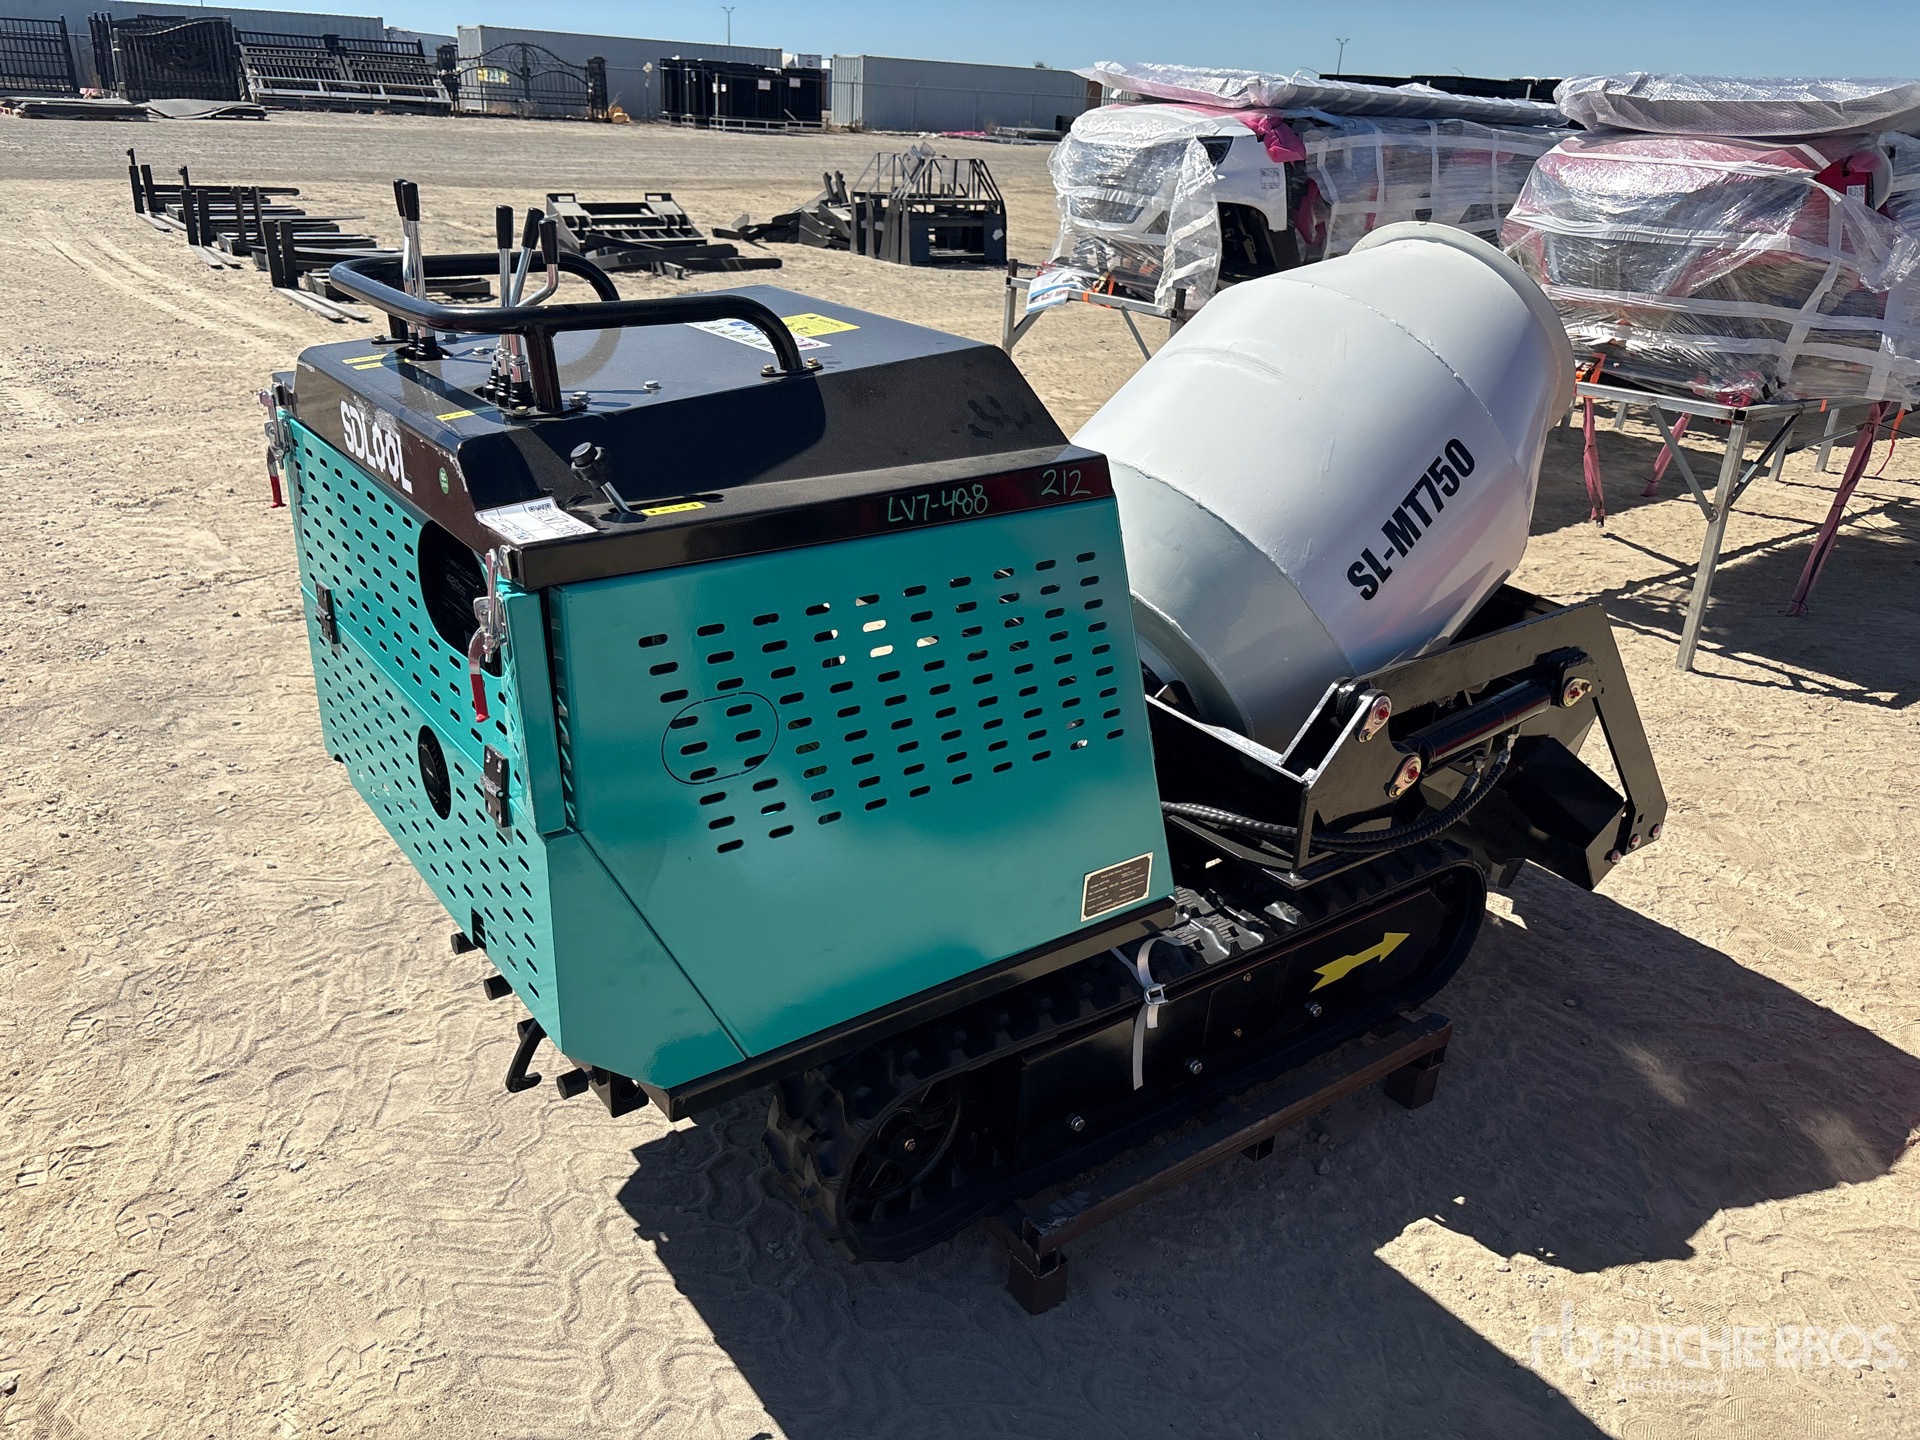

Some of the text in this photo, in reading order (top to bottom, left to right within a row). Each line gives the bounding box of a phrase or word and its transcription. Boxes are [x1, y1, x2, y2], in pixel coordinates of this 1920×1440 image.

[887, 483, 989, 523] LV7-488
[1041, 469, 1092, 497] 212
[1347, 438, 1475, 601] SL-MT750
